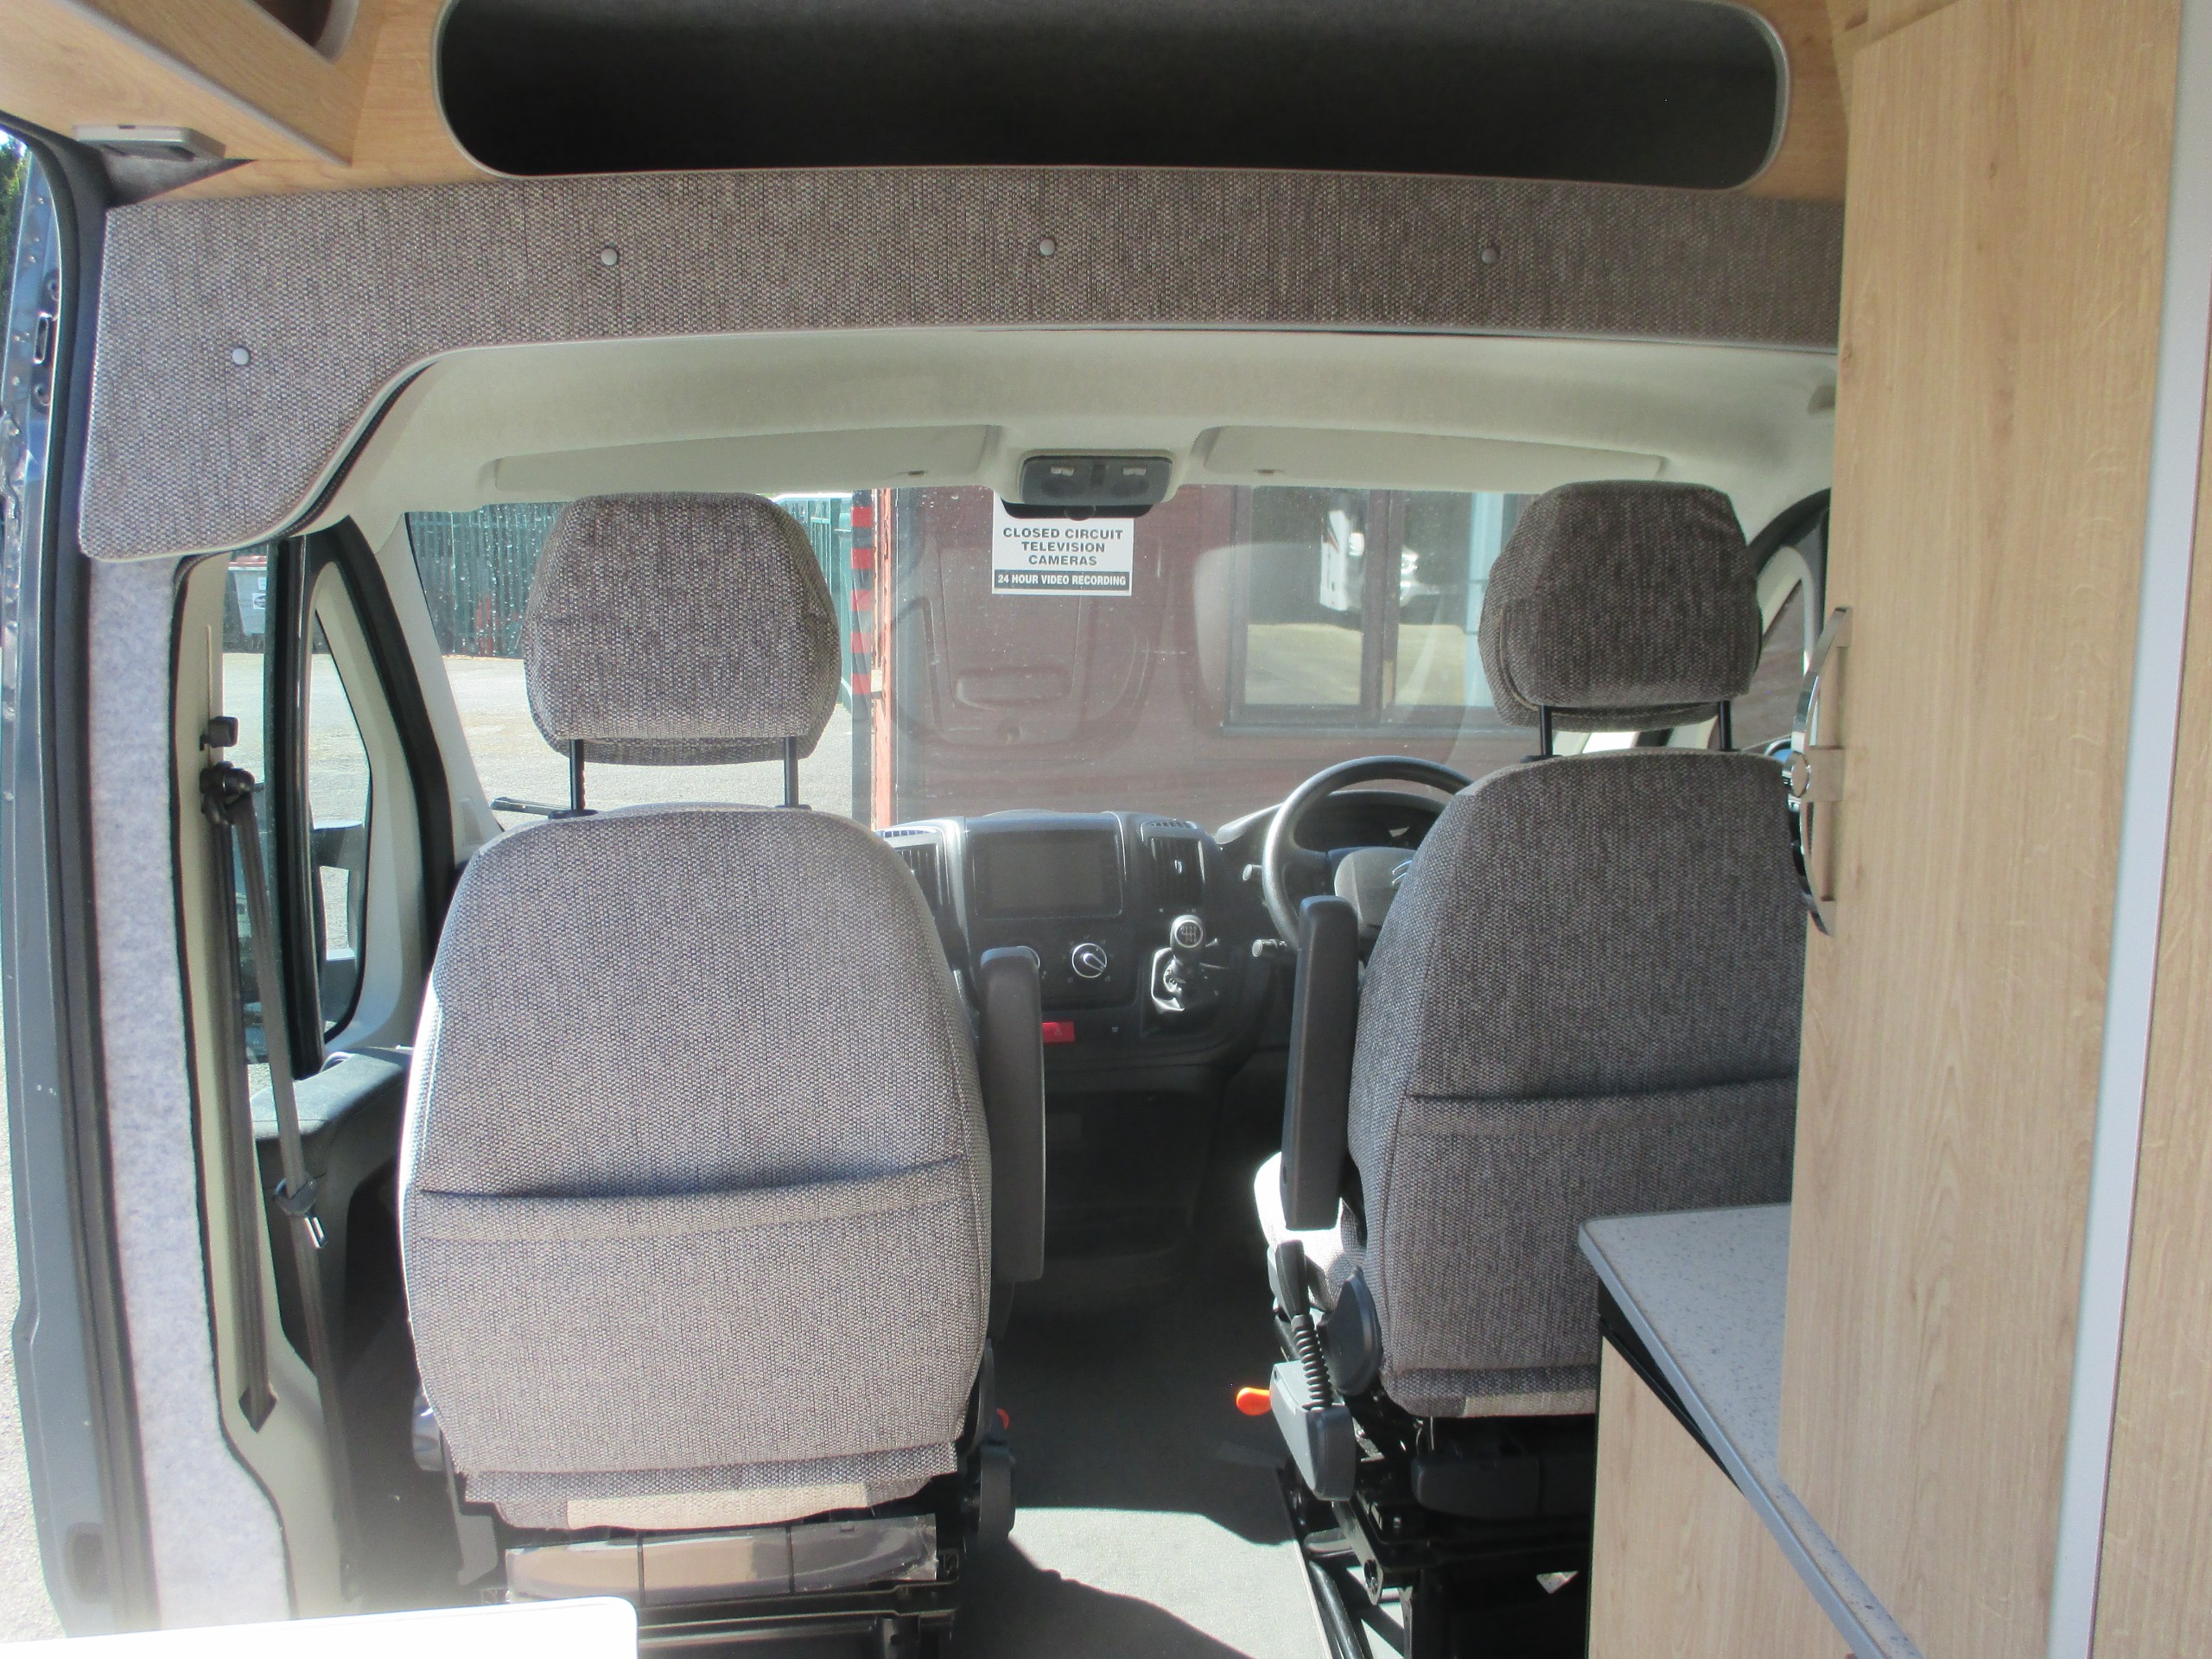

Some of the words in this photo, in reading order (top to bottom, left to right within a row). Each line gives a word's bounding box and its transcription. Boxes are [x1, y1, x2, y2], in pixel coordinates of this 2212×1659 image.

[1003, 527, 1060, 538] CLOSED
[1065, 529, 1123, 539] CIRCUIT
[1021, 541, 1105, 552] TELEVISION
[1028, 555, 1097, 566] CAMERAS
[998, 574, 1009, 583] 24
[1012, 574, 1039, 584] HOUR
[1041, 575, 1070, 585] VIDEO
[1071, 575, 1126, 586] RECORDING
